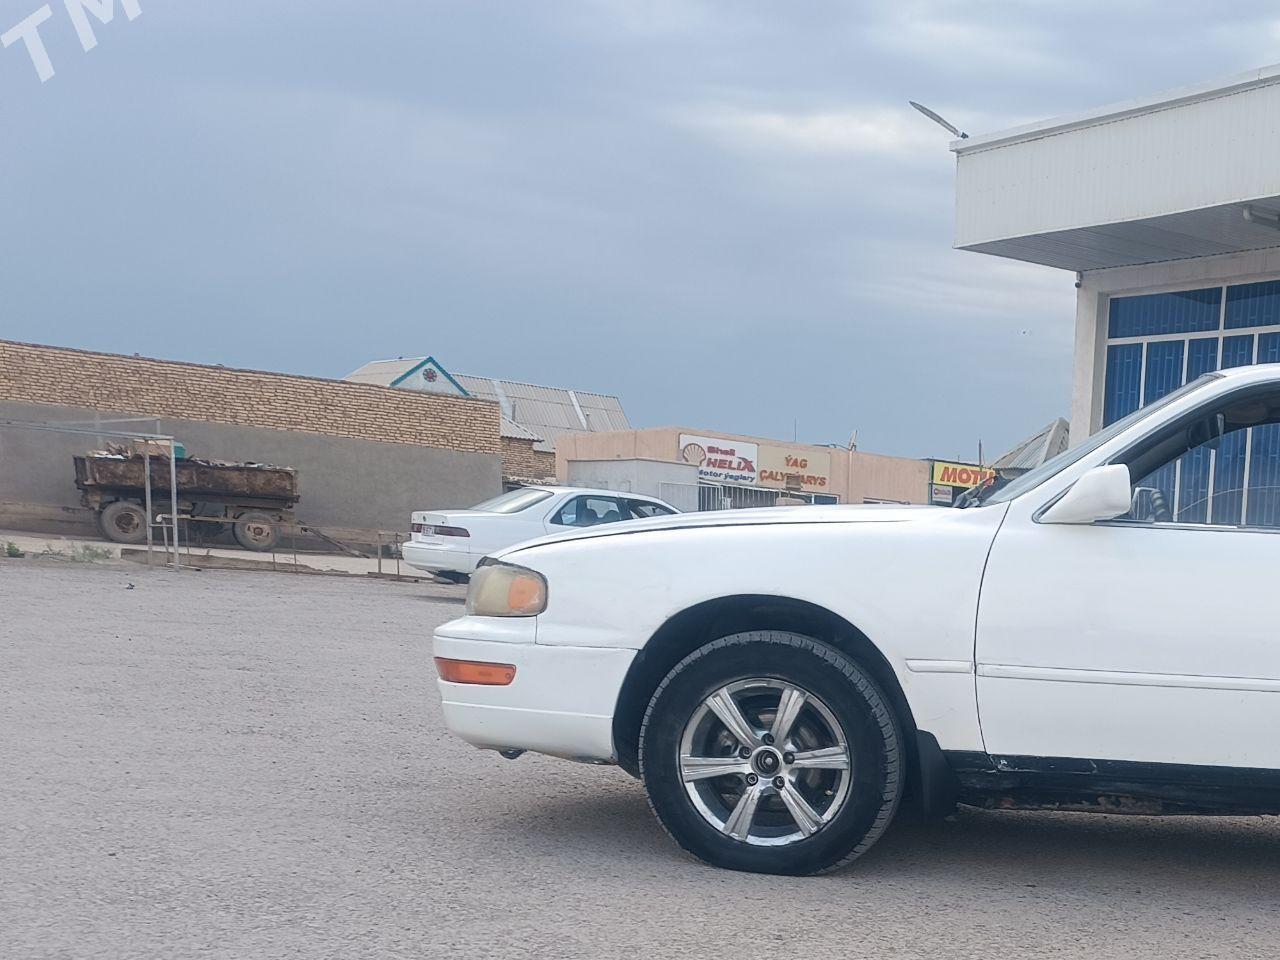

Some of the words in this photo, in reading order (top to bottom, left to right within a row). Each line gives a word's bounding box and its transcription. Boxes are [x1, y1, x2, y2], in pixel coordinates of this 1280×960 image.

[706, 457, 756, 473] HELIX
[785, 454, 808, 469] ÝAG
[940, 466, 994, 486] MOTU
